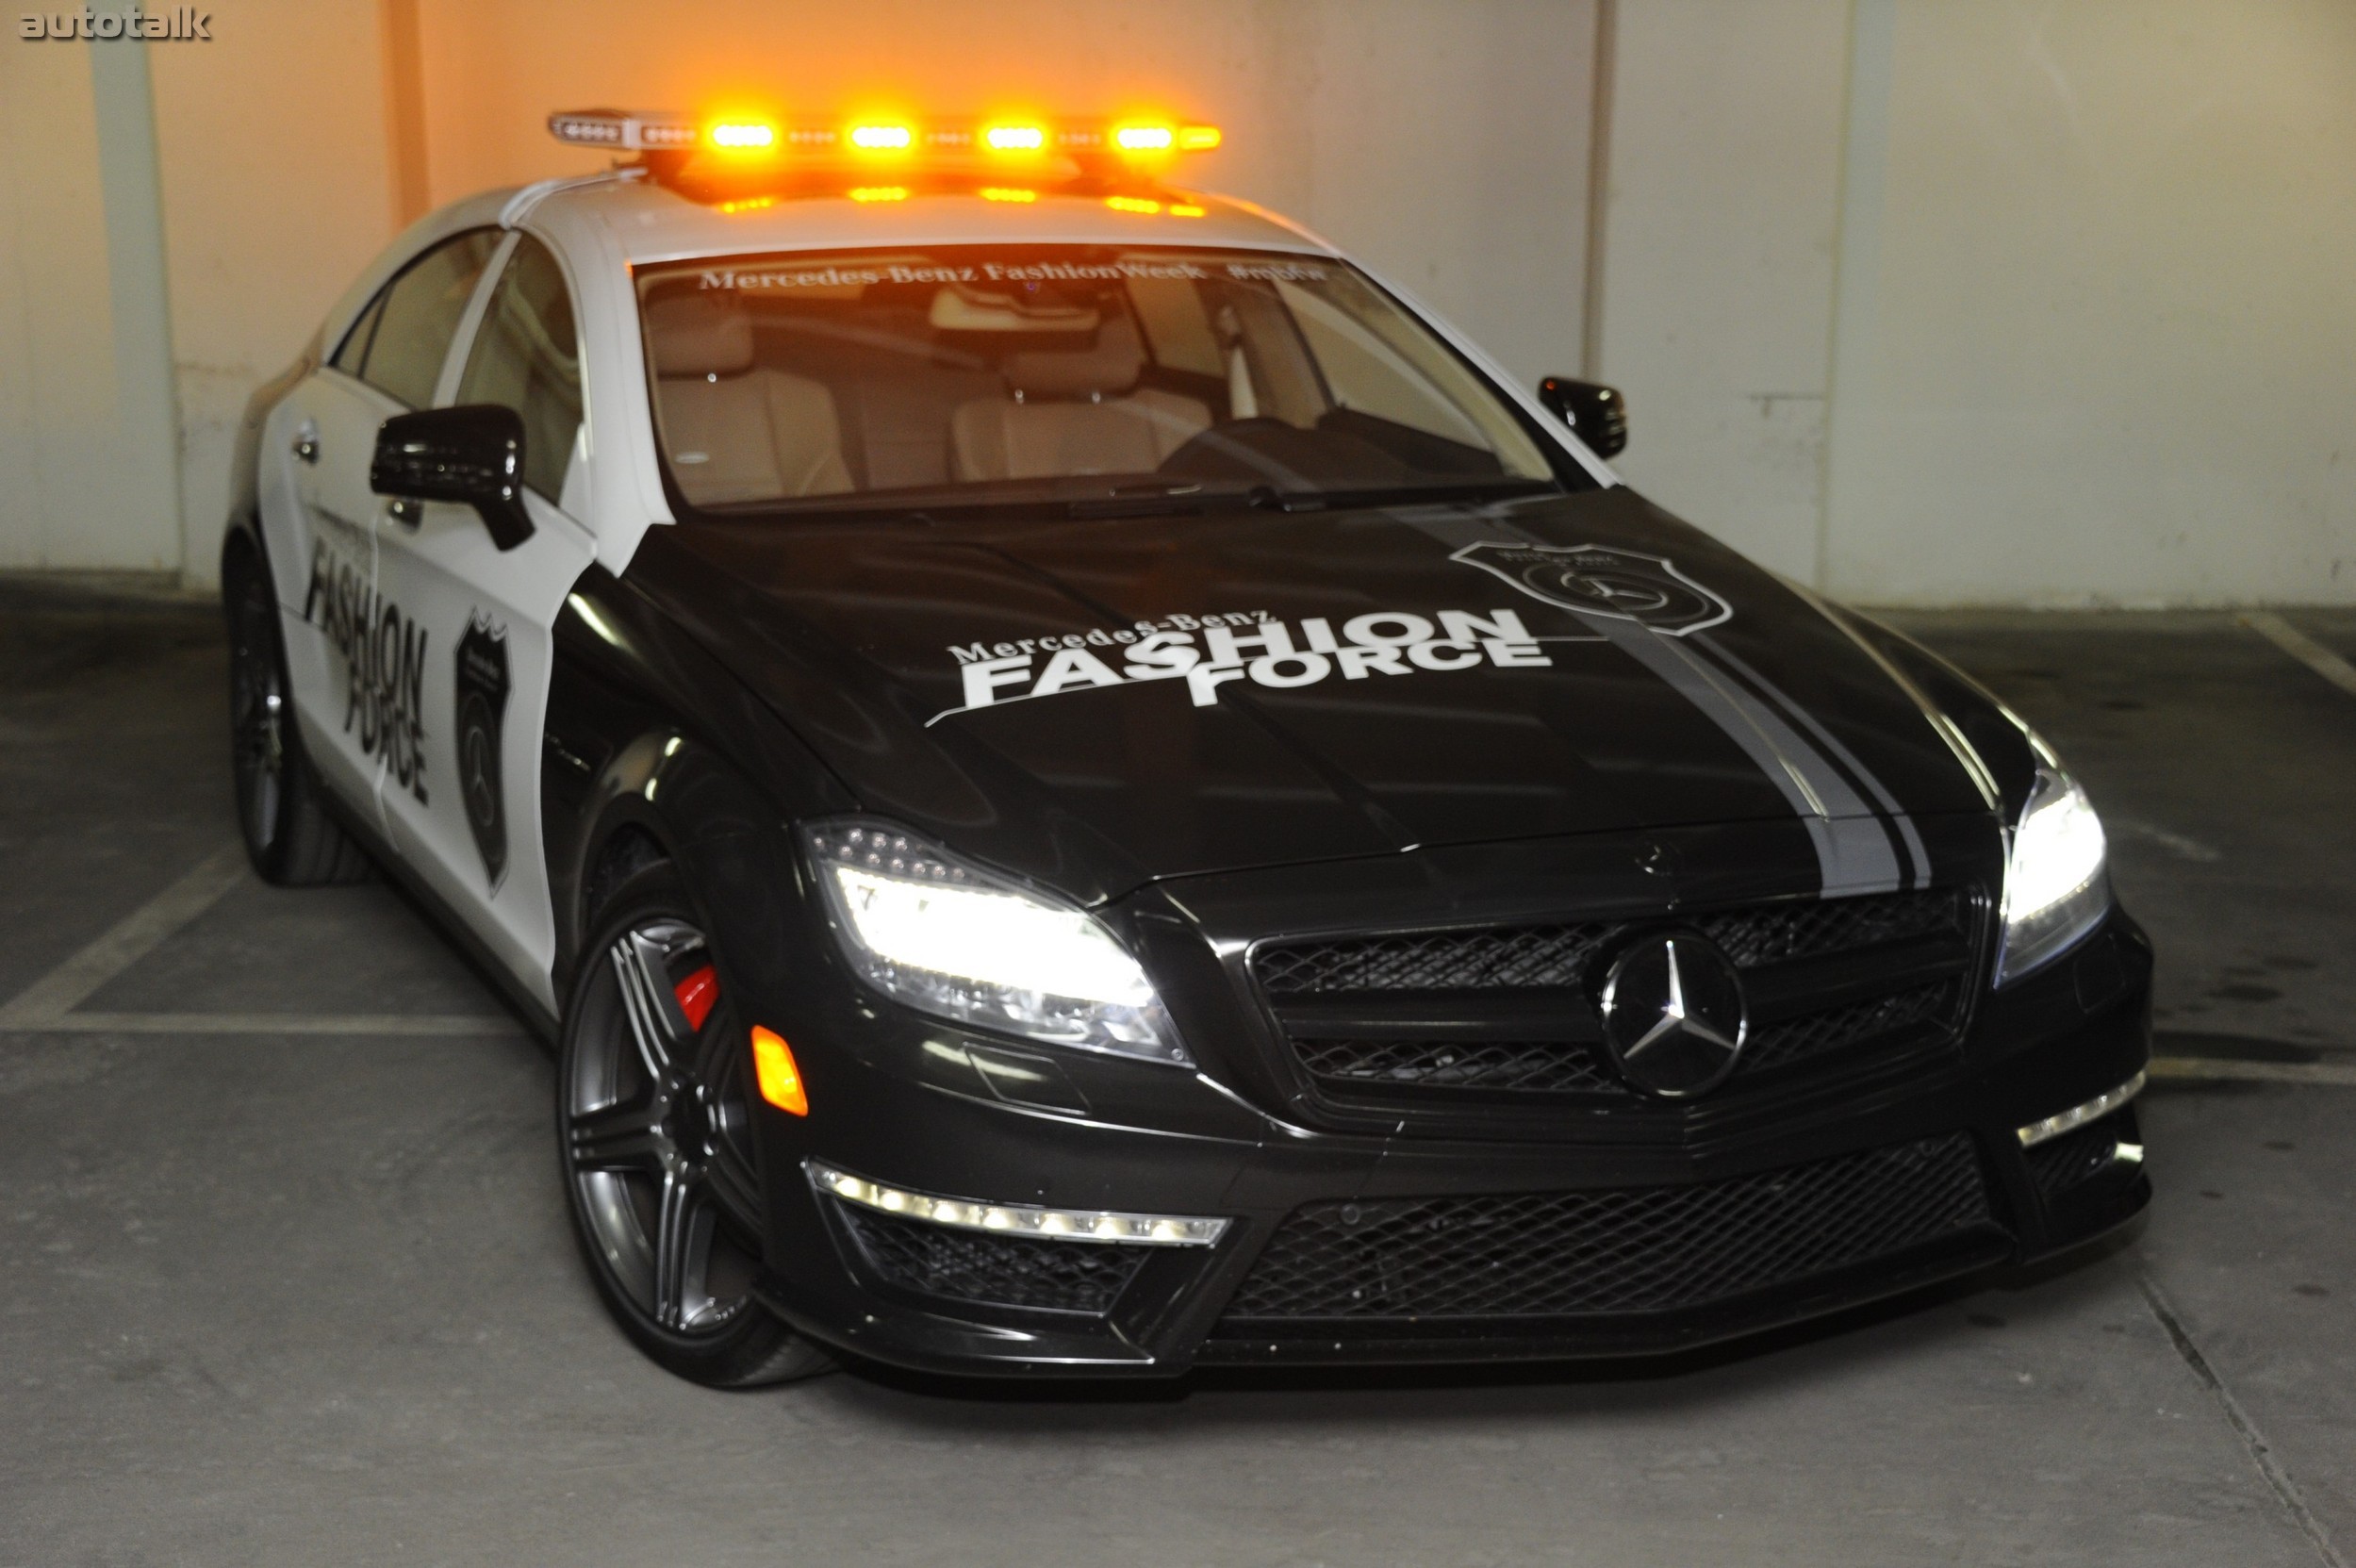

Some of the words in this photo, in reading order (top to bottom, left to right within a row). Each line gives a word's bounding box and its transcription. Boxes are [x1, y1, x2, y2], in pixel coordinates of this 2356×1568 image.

[700, 265, 979, 289] Mercedes-Benz
[305, 535, 429, 728] FASHION
[947, 610, 1277, 665] Mercedes-Benz
[962, 609, 1529, 708] FASHION
[1186, 637, 1552, 707] FORCE
